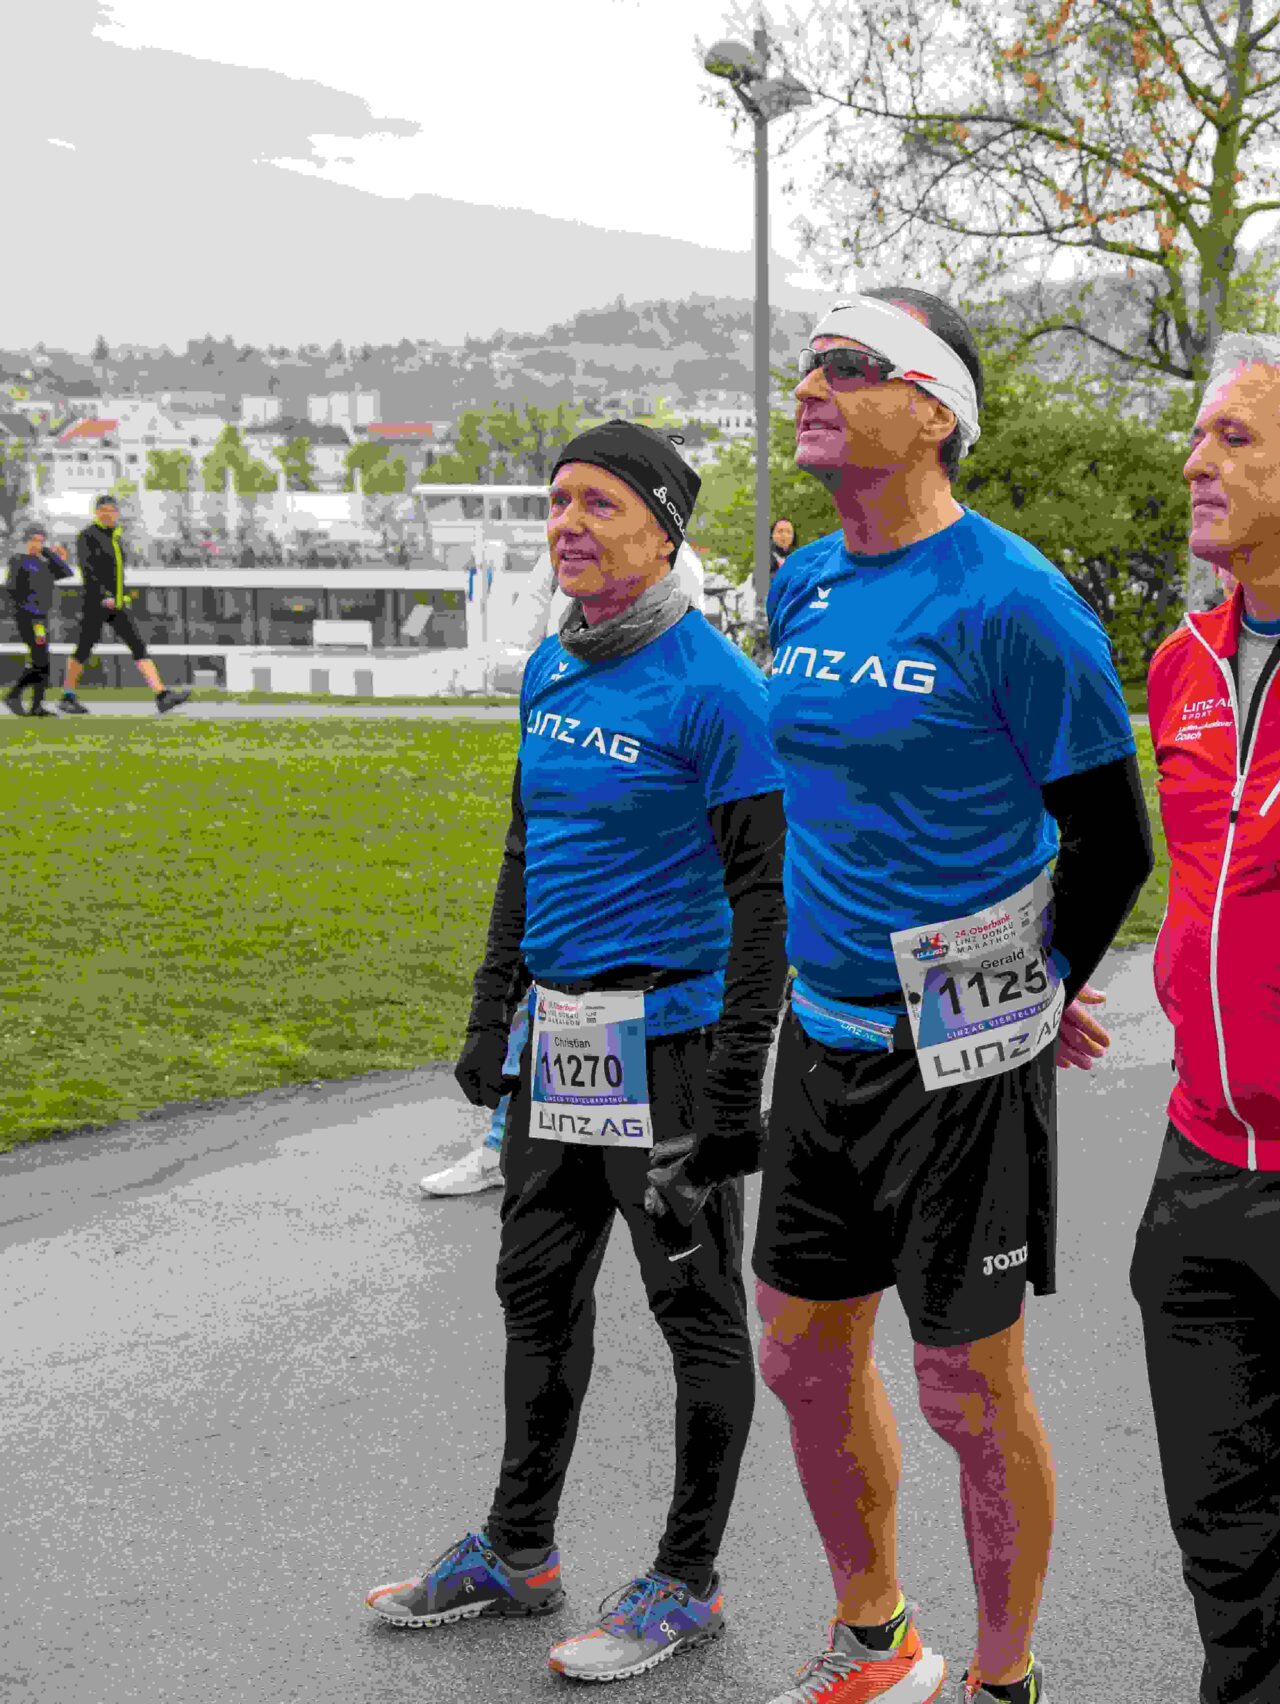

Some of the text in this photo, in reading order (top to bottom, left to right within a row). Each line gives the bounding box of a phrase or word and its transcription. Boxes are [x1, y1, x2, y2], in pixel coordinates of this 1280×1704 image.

[850, 655, 937, 694] AG
[581, 726, 641, 764] AG
[957, 931, 1017, 954] MARATHON
[982, 921, 1015, 940] DONAU
[980, 948, 1025, 969] Gerald
[939, 946, 1047, 1015] 1125
[554, 1036, 591, 1048] Christian
[933, 1032, 1031, 1078] LINZ
[541, 1051, 624, 1088] 11270
[539, 1111, 644, 1138] LINZ AG
